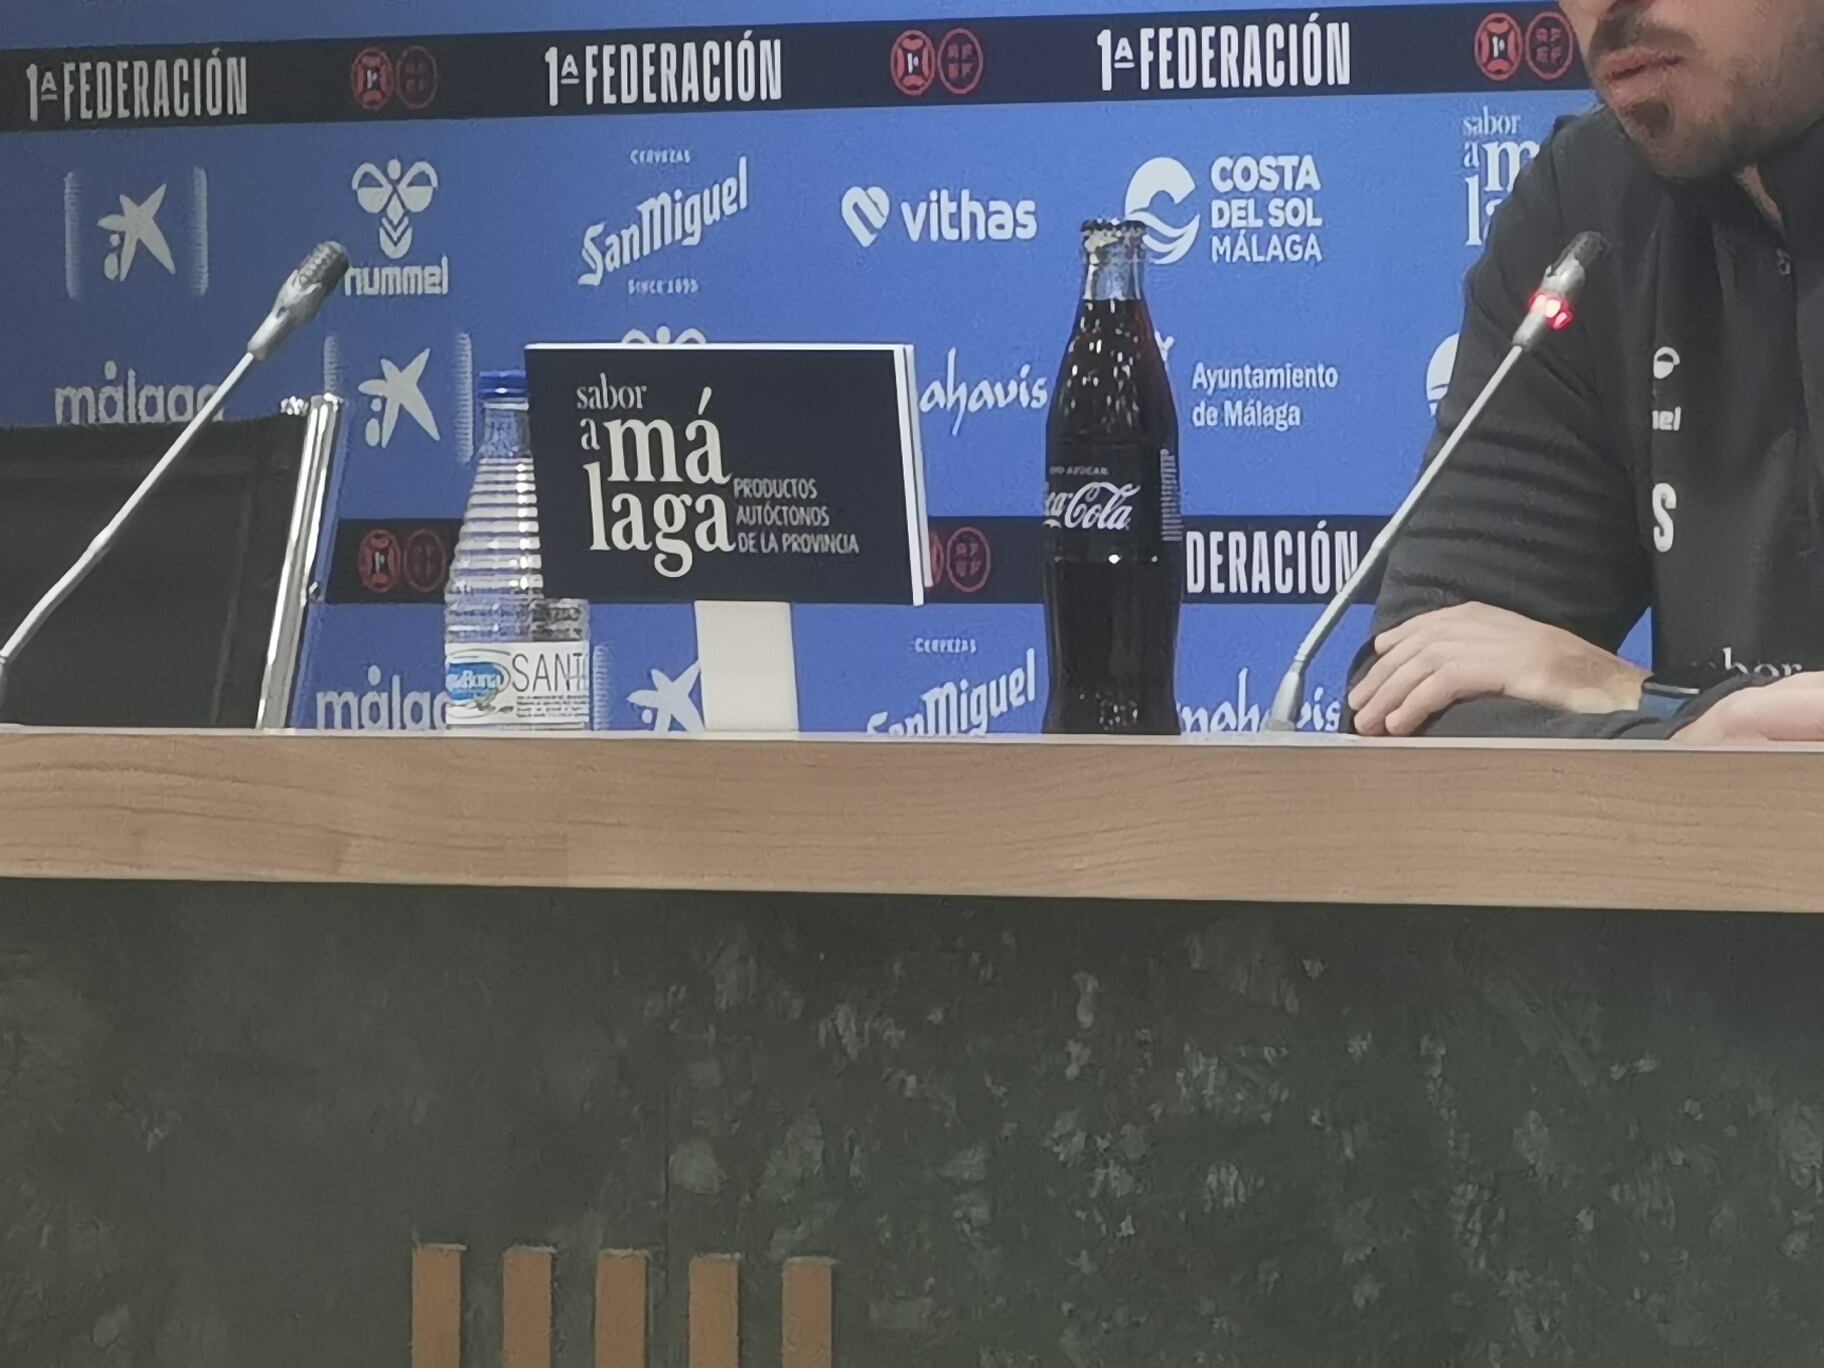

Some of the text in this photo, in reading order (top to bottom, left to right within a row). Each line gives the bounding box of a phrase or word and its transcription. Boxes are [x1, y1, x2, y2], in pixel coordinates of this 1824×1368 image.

[586, 30, 781, 104] FEDERACIÓN
[1140, 13, 1349, 89] FEDERACIÓN
[64, 48, 247, 120] FEDERACIÓN
[1463, 106, 1520, 136] sabor
[1211, 155, 1320, 192] COSTA
[901, 190, 1036, 241] vithas
[1212, 198, 1322, 228] DEL SOL
[1212, 229, 1322, 262] MÁLAGA
[577, 373, 646, 409] sabor
[1193, 363, 1338, 395] Ayuntamiento
[1193, 399, 1300, 431] de Málaga
[580, 387, 730, 484] a má
[733, 478, 817, 499] PRODUCTOS
[584, 458, 735, 577] laga
[736, 501, 829, 526] AUTÓCTONOS
[738, 532, 859, 553] DE LA PROVINCIA
